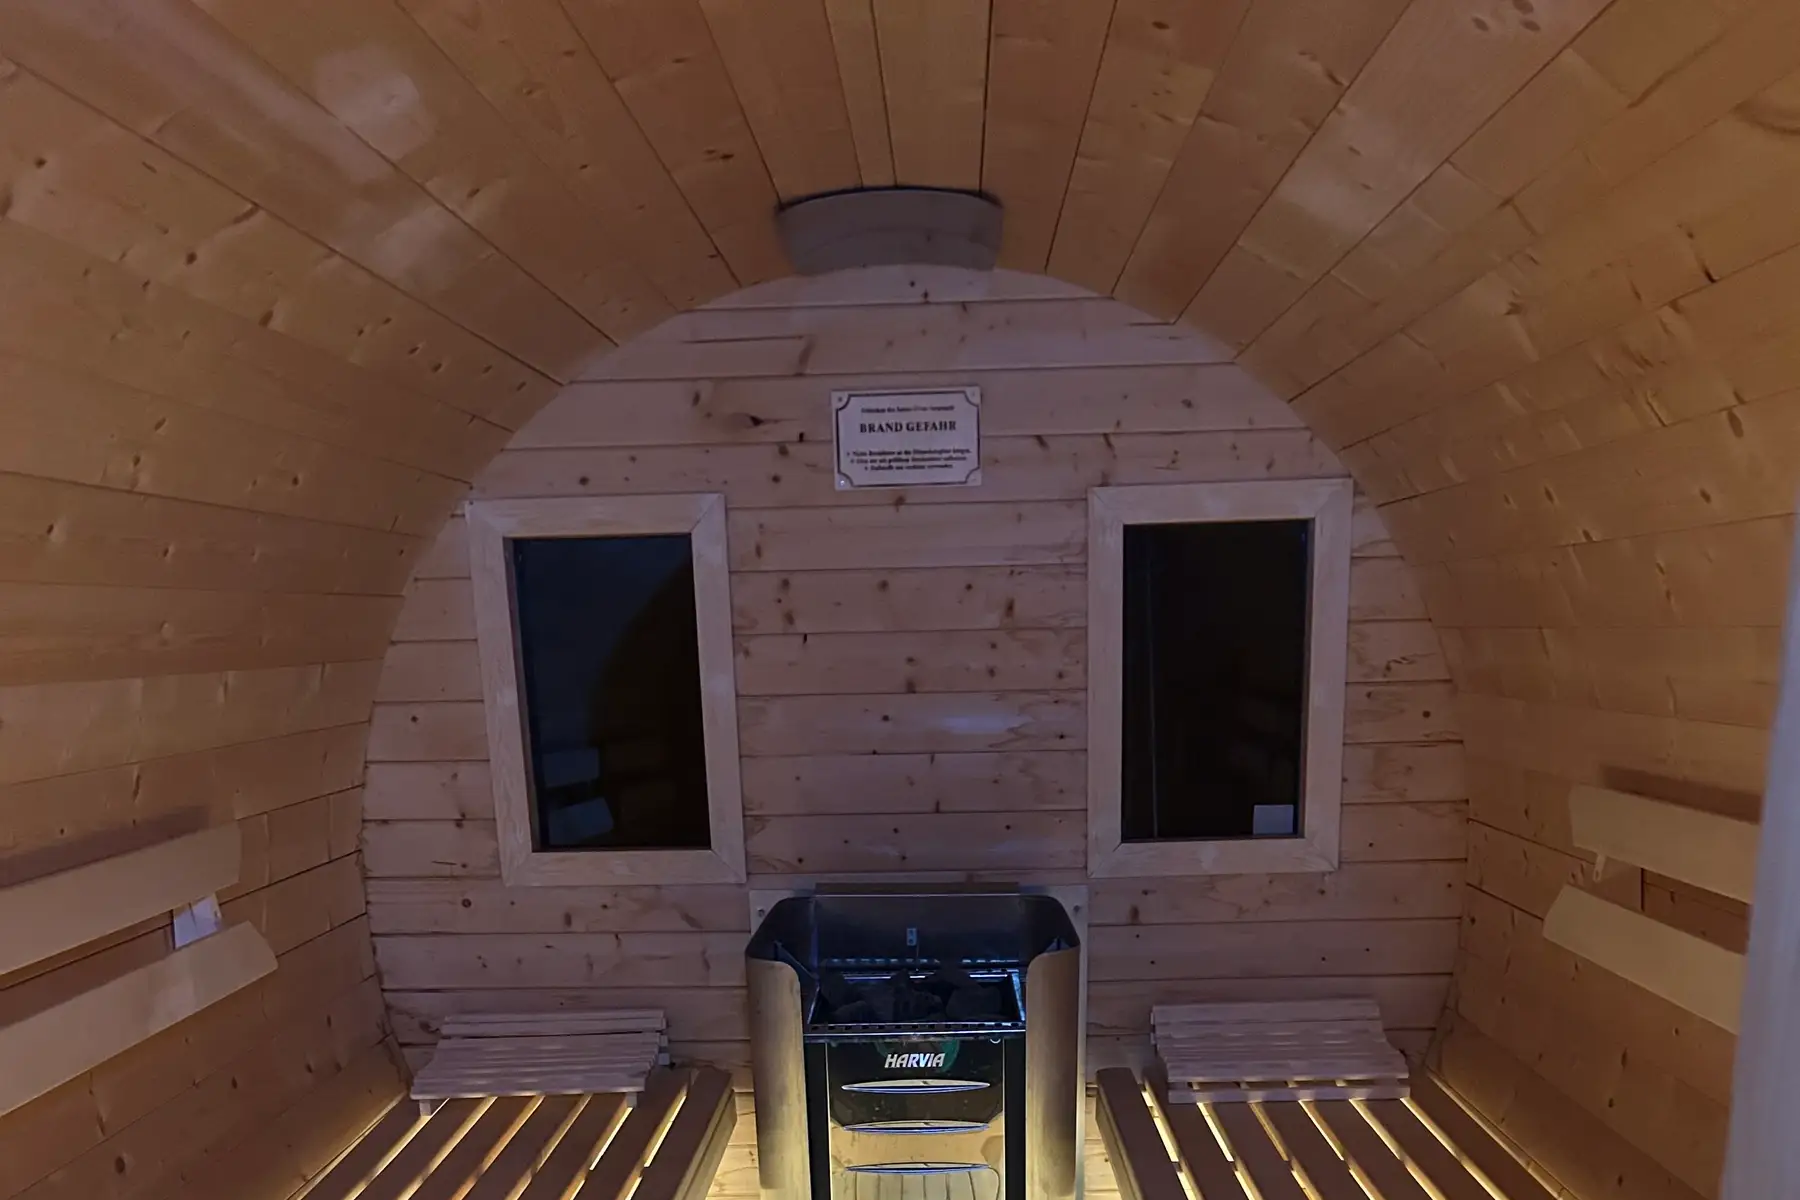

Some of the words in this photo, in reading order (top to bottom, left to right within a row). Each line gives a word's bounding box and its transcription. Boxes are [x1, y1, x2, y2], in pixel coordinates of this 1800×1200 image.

[859, 421, 903, 433] BRAND
[905, 420, 957, 432] GEFAHR
[884, 1053, 946, 1069] HARVIA
